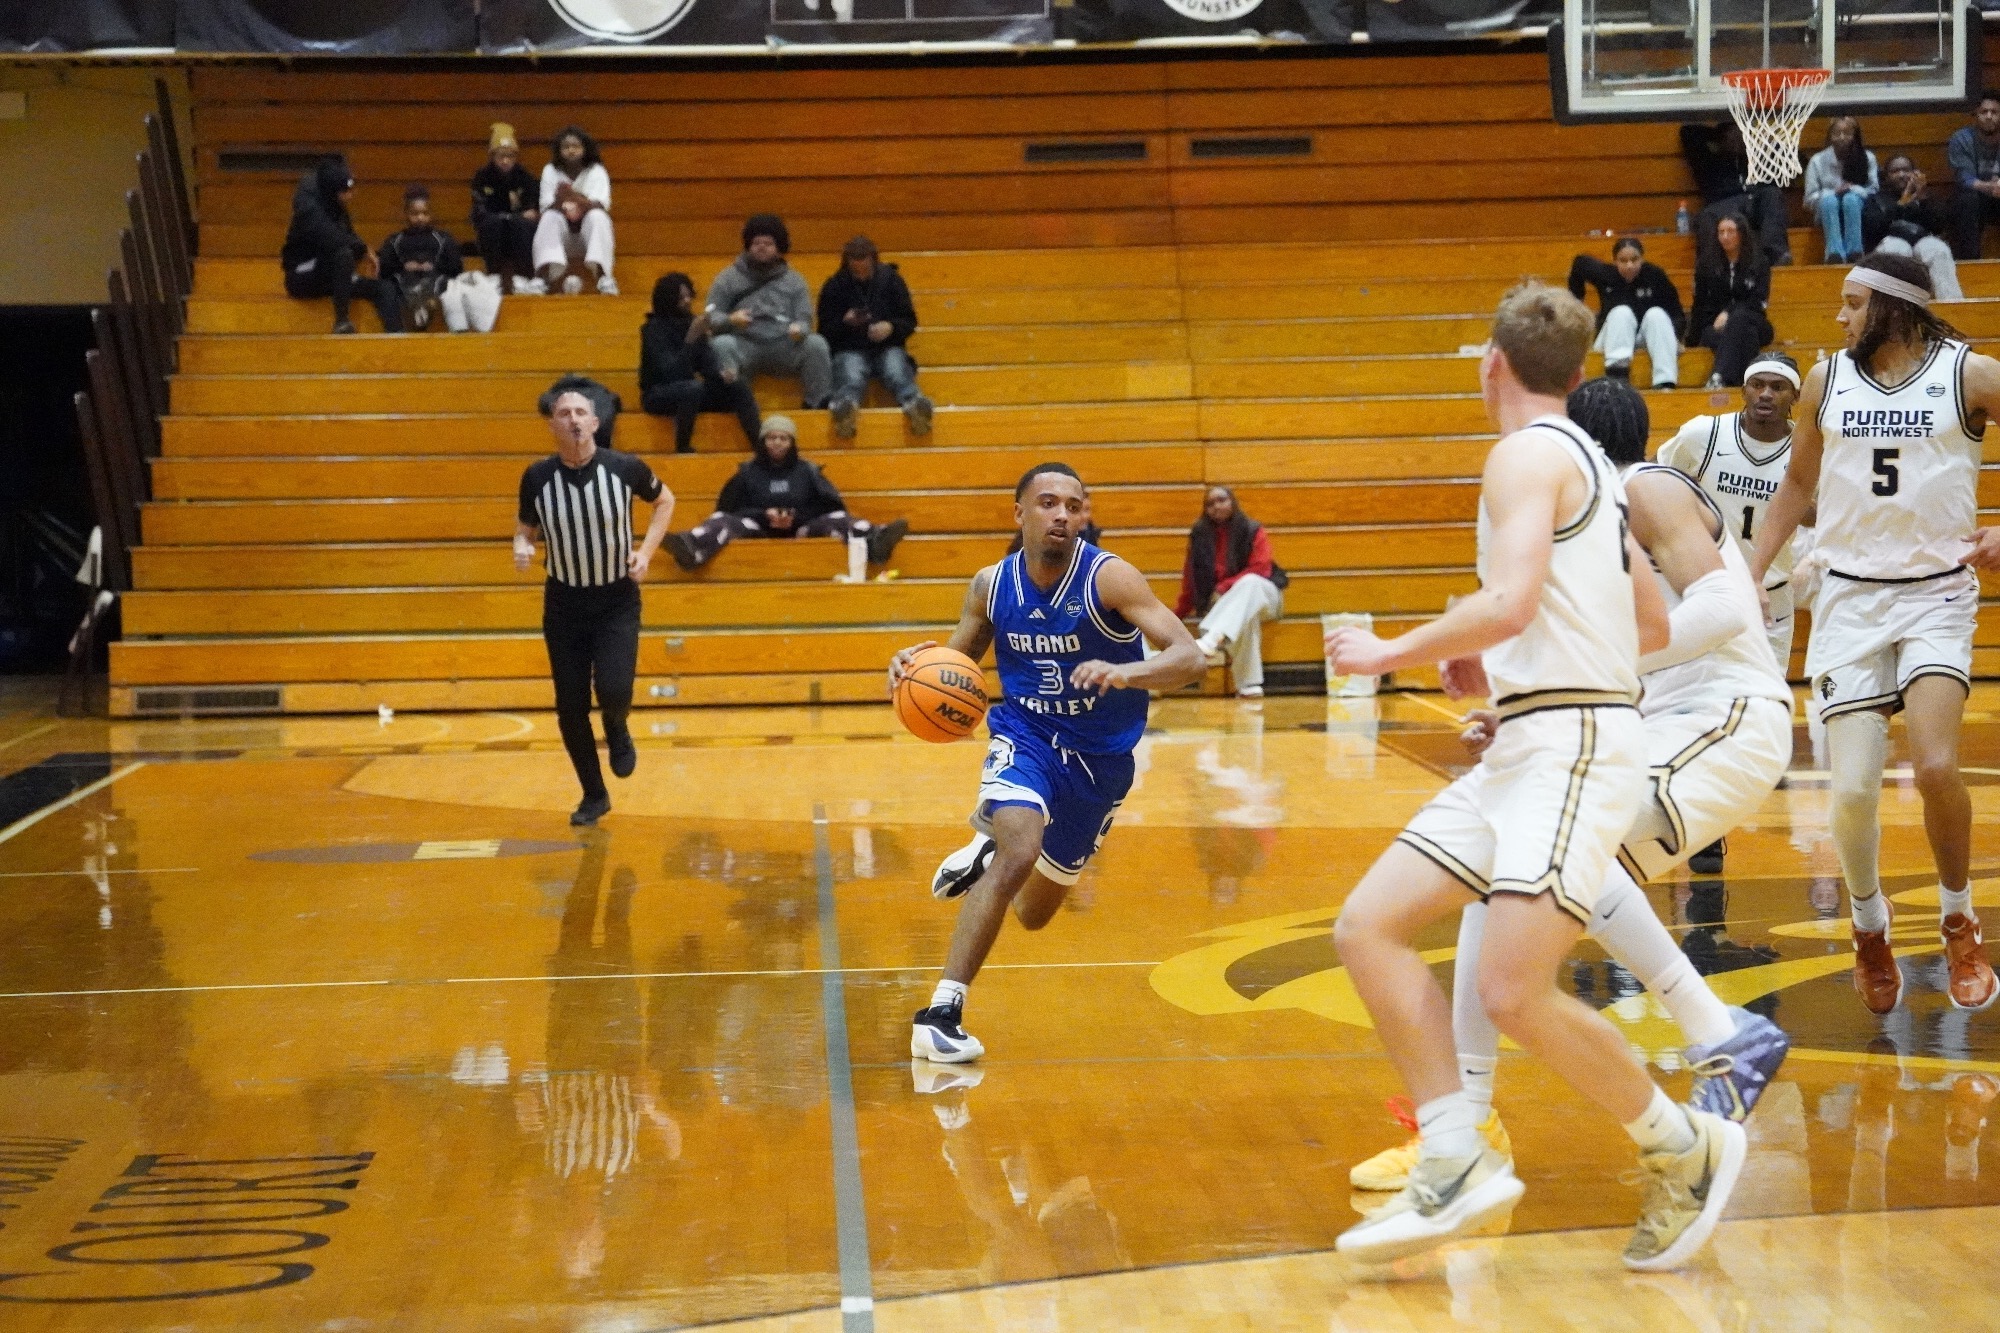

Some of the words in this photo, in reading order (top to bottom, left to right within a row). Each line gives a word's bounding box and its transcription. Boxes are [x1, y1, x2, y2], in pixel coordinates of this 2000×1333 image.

[1842, 410, 1934, 426] PURDUE
[1842, 427, 1934, 438] NORTHWEST
[1718, 471, 1778, 493] PURDU
[1872, 448, 1899, 497] 5
[1717, 484, 1772, 501] NORTHWE
[1742, 505, 1754, 540] 1
[1007, 632, 1081, 653] GRAND
[1032, 660, 1064, 695] 3
[0, 1151, 377, 1303] COURT
